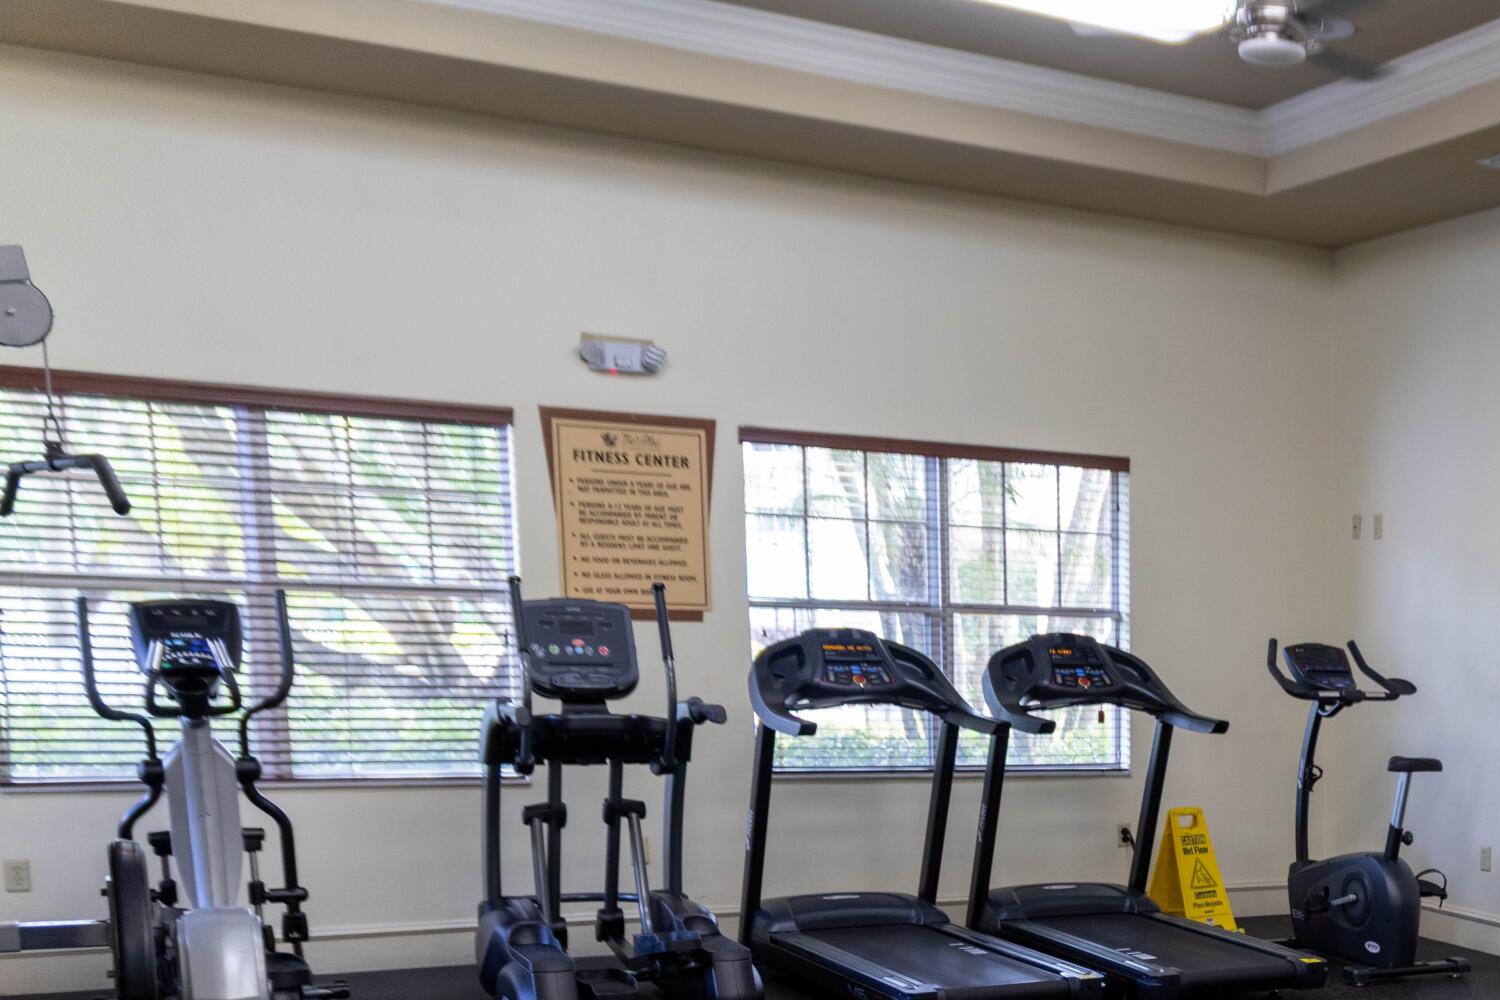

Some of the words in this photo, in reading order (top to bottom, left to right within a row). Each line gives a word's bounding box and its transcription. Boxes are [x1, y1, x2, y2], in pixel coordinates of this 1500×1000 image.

[572, 448, 630, 464] FITNESS
[635, 453, 690, 469] CENTER
[1180, 834, 1206, 845] CAUTION
[1182, 847, 1194, 855] Wet
[1195, 846, 1208, 854] Floor
